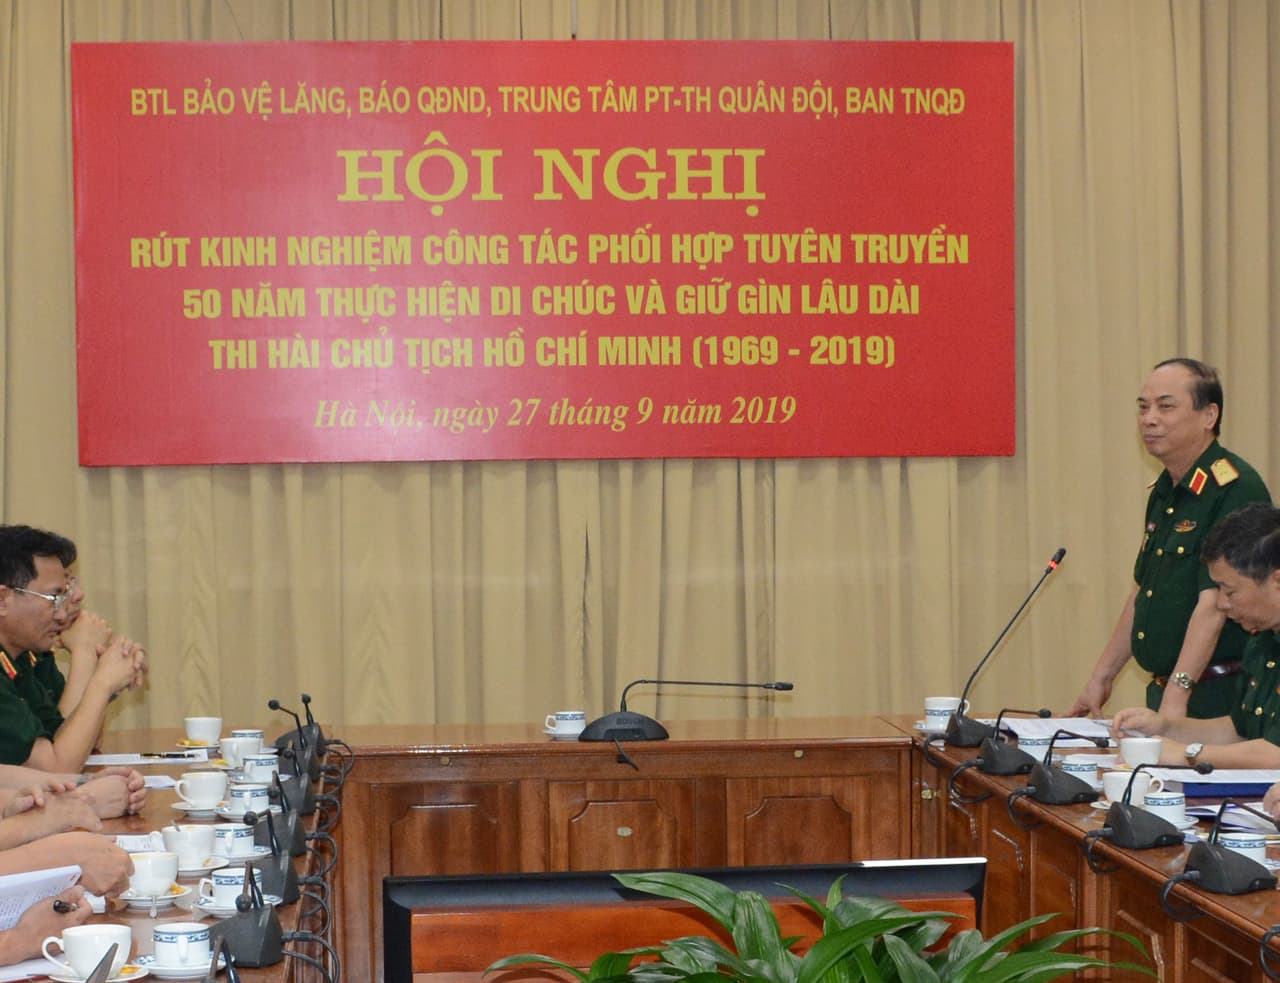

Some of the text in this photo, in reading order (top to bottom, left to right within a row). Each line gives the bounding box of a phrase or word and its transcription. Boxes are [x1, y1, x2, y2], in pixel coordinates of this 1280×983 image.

[130, 85, 177, 117] BTL
[182, 77, 236, 117] BẢO
[241, 79, 274, 122] VỆ
[358, 80, 411, 114] BÁO
[417, 84, 492, 118] QĐND,
[497, 84, 582, 115] TRUNG
[586, 79, 638, 114] TÂM
[643, 83, 713, 113] PT-TH
[718, 79, 786, 114] QUÂN
[791, 79, 839, 120] ĐỘI,
[845, 86, 895, 114] BAN
[900, 86, 966, 116] TNQĐ
[336, 129, 767, 217] HỘI NGHỊ
[129, 224, 970, 273] RÚT KINH NGHIỆM CÔNG TÁC PHỐI HỢP TUYÊN TRUYỀN
[182, 276, 921, 324] 50 NĂM THỰC HIỆN DI CHÚC VÀ GIỮ GÌN LÂU DÀI
[208, 339, 258, 370] THI
[267, 333, 321, 369] HÀI
[330, 326, 394, 369] CHỦ
[403, 338, 474, 374] TỊCH
[483, 327, 527, 368] HỒ
[535, 331, 589, 367] CHÍ
[597, 335, 682, 366] MINH
[691, 335, 780, 369] (1969
[809, 335, 896, 369] 2019)
[313, 400, 358, 429] Hà
[432, 400, 500, 435] ngày
[507, 398, 542, 427] 27
[548, 397, 630, 432] tháng
[635, 395, 655, 426] 9
[661, 399, 723, 425] năm
[728, 395, 798, 425] 2019
